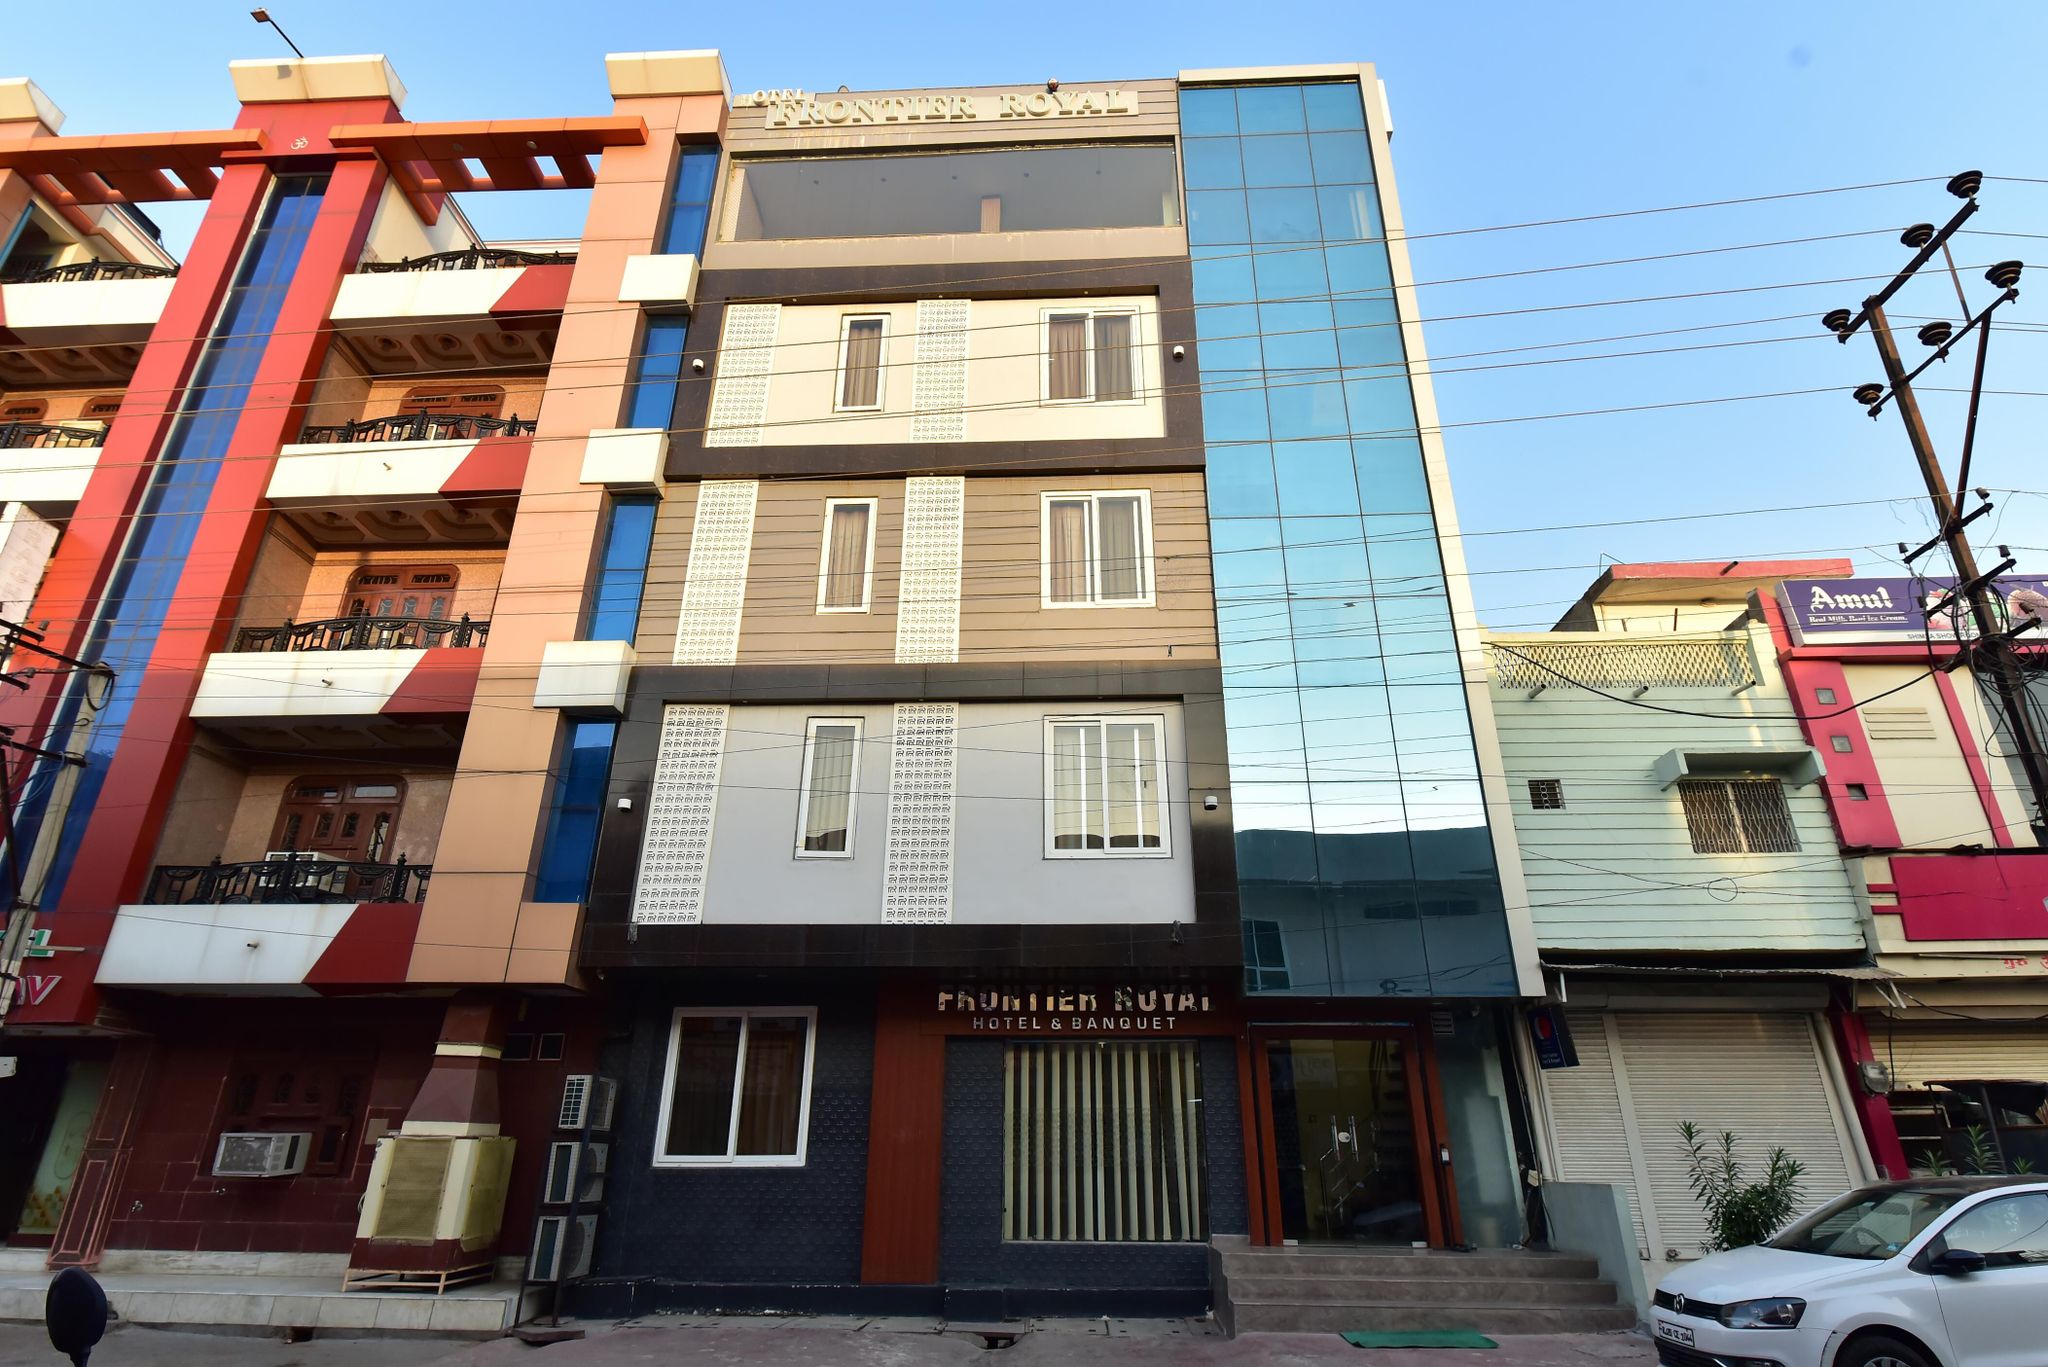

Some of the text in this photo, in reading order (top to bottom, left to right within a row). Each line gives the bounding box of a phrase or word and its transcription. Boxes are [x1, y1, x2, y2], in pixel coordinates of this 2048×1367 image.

[773, 88, 1130, 126] FRONTIER ROYAL
[1810, 585, 1893, 613] Amul
[938, 985, 1217, 1012] FRONTIER ROYAL
[973, 1017, 1176, 1030] HOTEL & BANQUET
